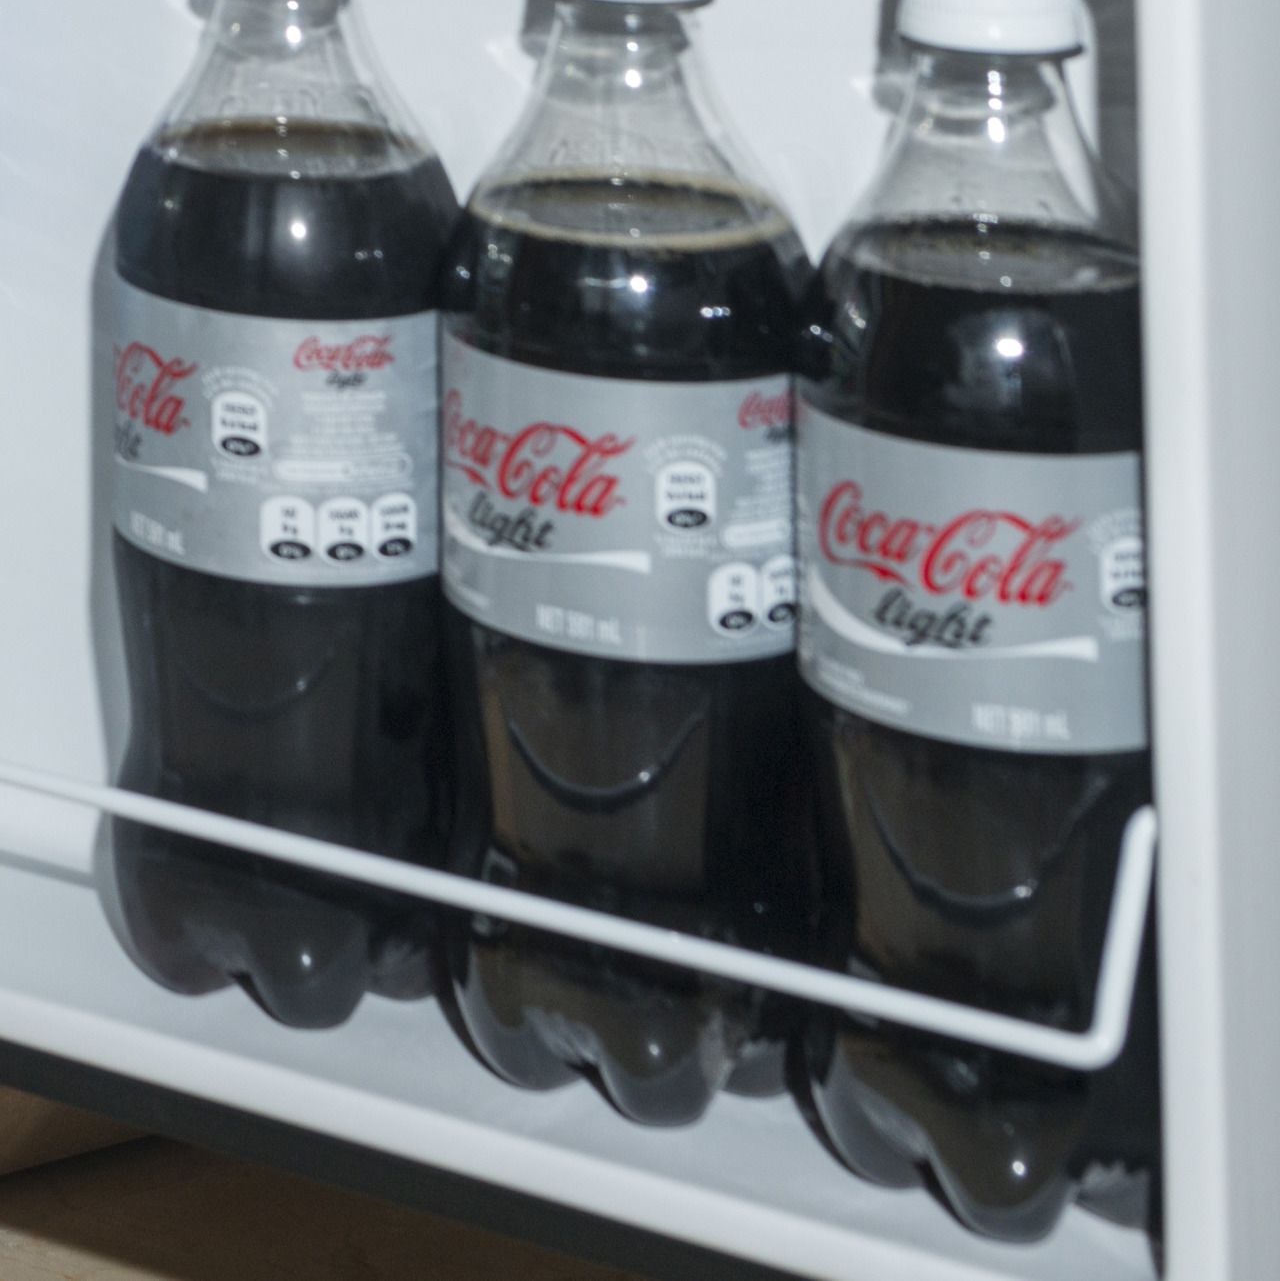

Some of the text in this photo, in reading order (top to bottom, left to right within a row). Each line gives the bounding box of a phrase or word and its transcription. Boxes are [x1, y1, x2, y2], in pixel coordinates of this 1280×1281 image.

[468, 490, 556, 553] light
[816, 478, 1083, 609] Coca-Cola
[872, 586, 993, 649] light
